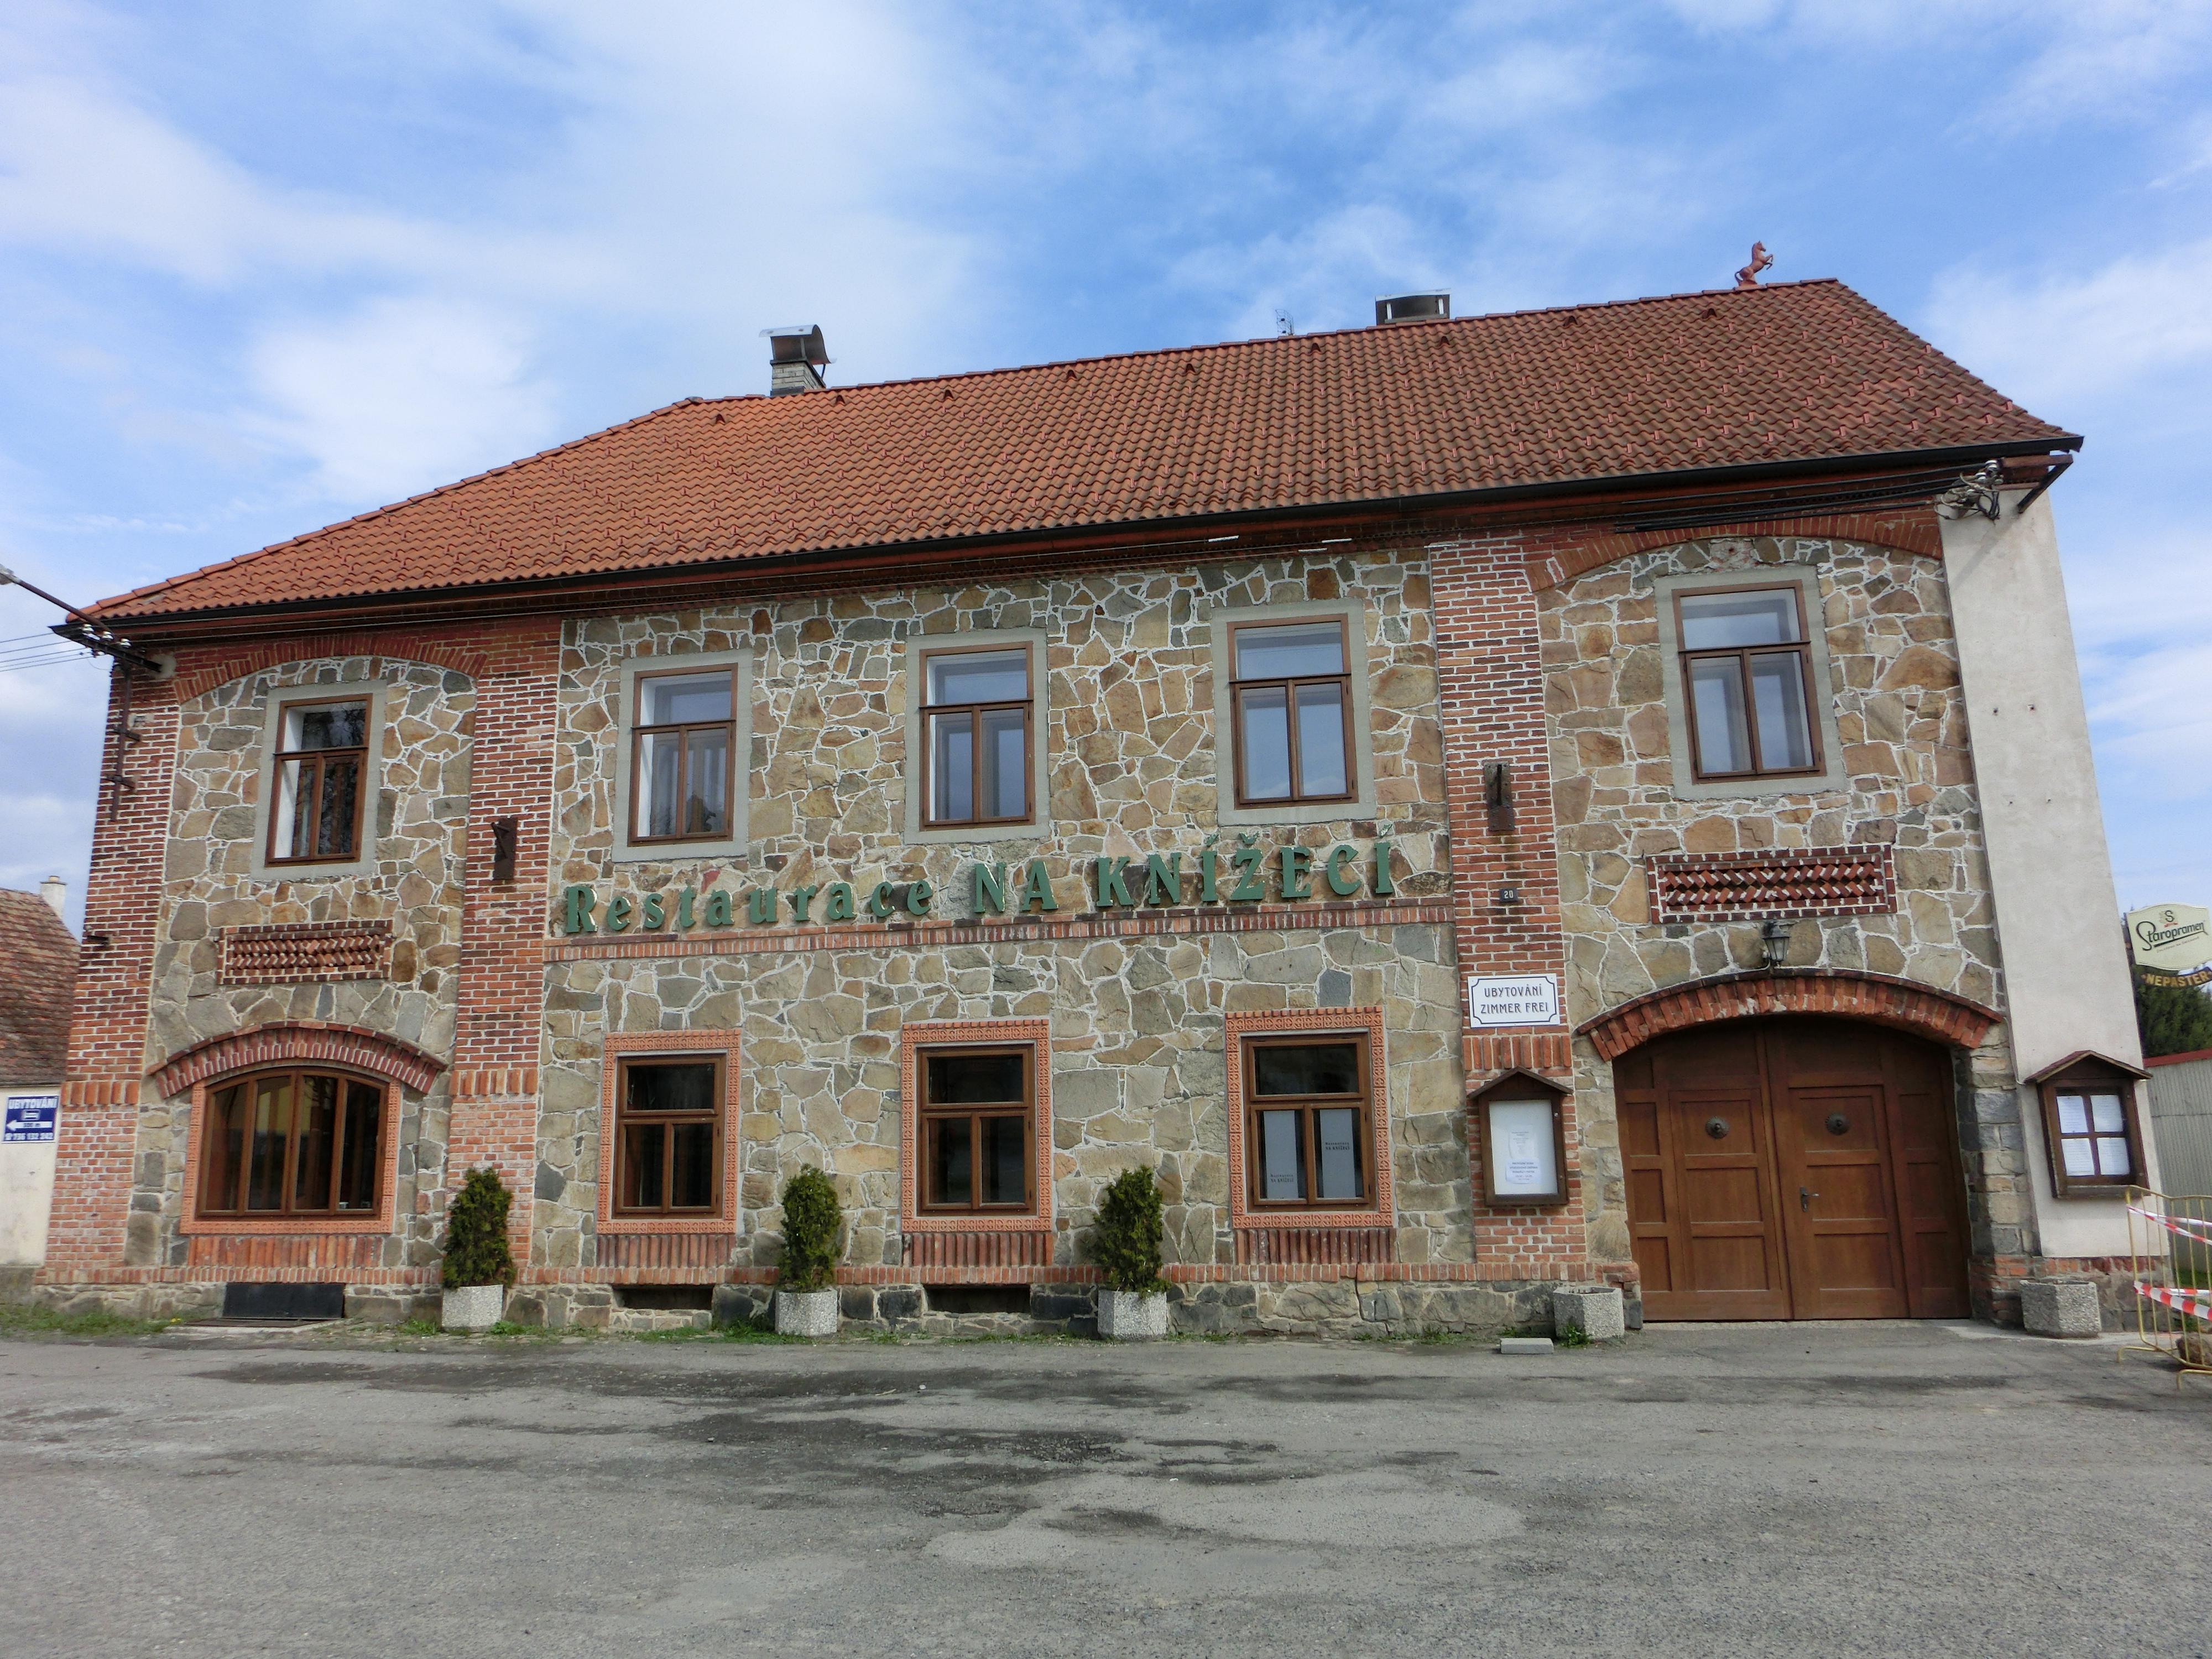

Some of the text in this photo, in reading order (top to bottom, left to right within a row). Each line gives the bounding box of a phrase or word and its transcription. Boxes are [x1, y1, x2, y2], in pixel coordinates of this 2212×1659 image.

[564, 823, 1395, 933] Restaurace NA KNÍŽECÍ
[1504, 890, 1514, 899] 20
[2135, 920, 2205, 951] Staropramen
[2145, 971, 2209, 988] NEPASTER
[1484, 983, 1542, 998] UBYTOVÁNÍ
[1480, 1001, 1549, 1015] ZIMMER FREI
